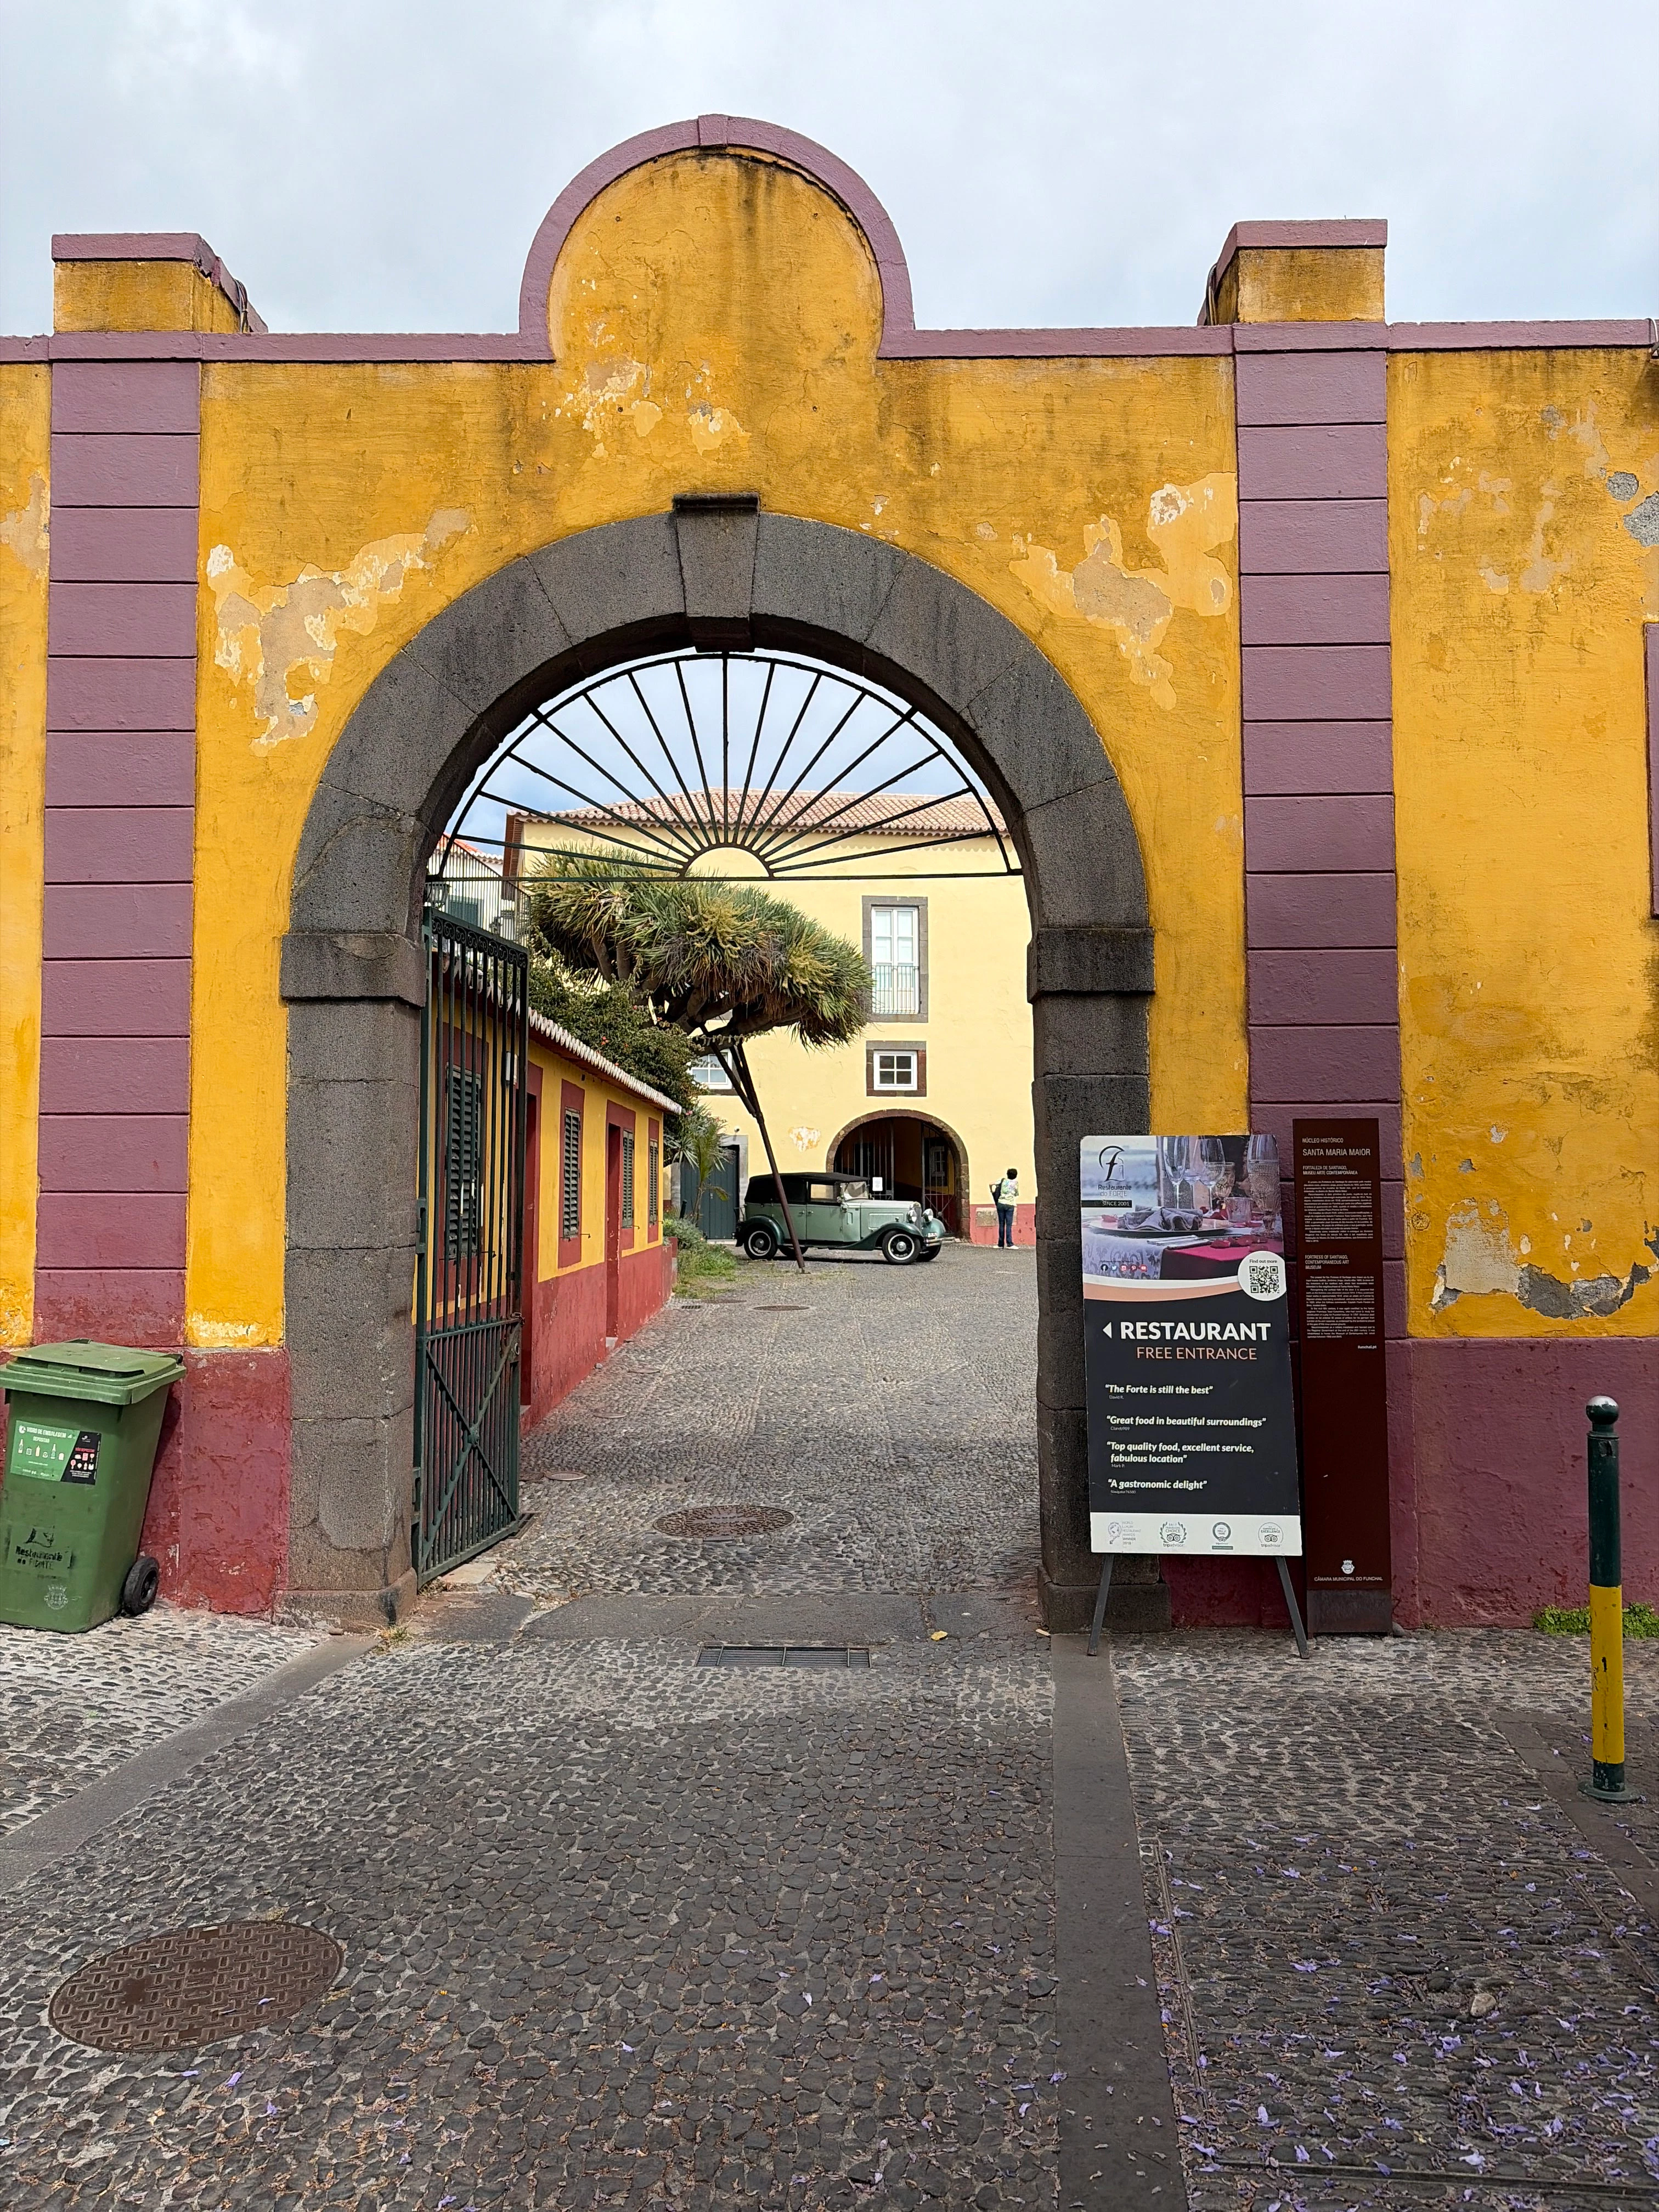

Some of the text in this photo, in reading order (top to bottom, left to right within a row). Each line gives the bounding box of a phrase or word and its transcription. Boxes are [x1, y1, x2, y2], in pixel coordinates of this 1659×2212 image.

[1302, 1148, 1371, 1156] SANTA MARIA MAIOR
[1120, 1322, 1271, 1341] RESTAURANT
[1137, 1347, 1257, 1360] FREE ENTRANCE
[1105, 1384, 1214, 1394] “The Forte is still the best”
[1106, 1415, 1267, 1428] “Great food in beautiful surroundings”
[1107, 1441, 1255, 1453] “Top quality food, excellent service,
[1110, 1453, 1187, 1463] fabulous location”
[1108, 1479, 1207, 1490] “A gastronomic delight”
